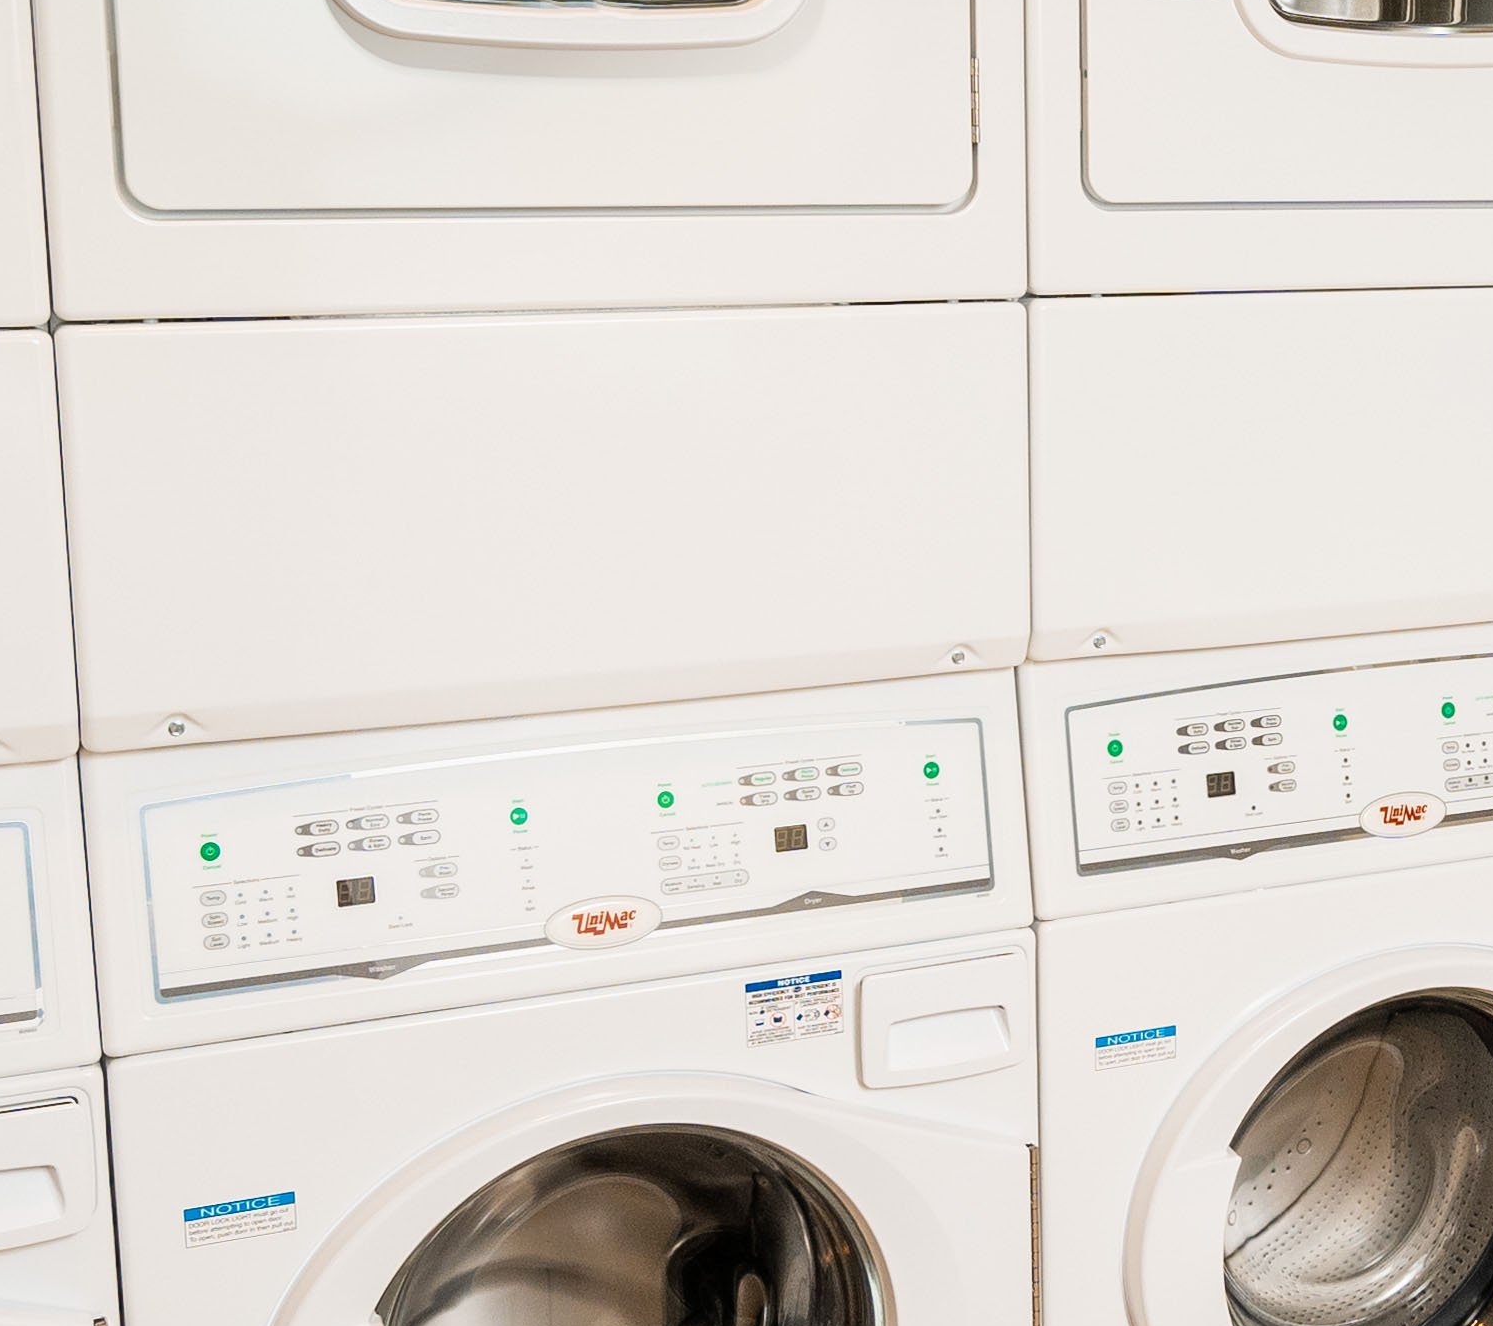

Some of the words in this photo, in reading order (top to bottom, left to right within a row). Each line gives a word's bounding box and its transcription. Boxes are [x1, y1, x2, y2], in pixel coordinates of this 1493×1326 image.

[1379, 804, 1428, 826] UniMac
[571, 909, 637, 936] UniMac
[777, 975, 811, 987] NOTICE
[1107, 1028, 1165, 1045] NOTICE
[200, 1195, 281, 1218] NOTICE
